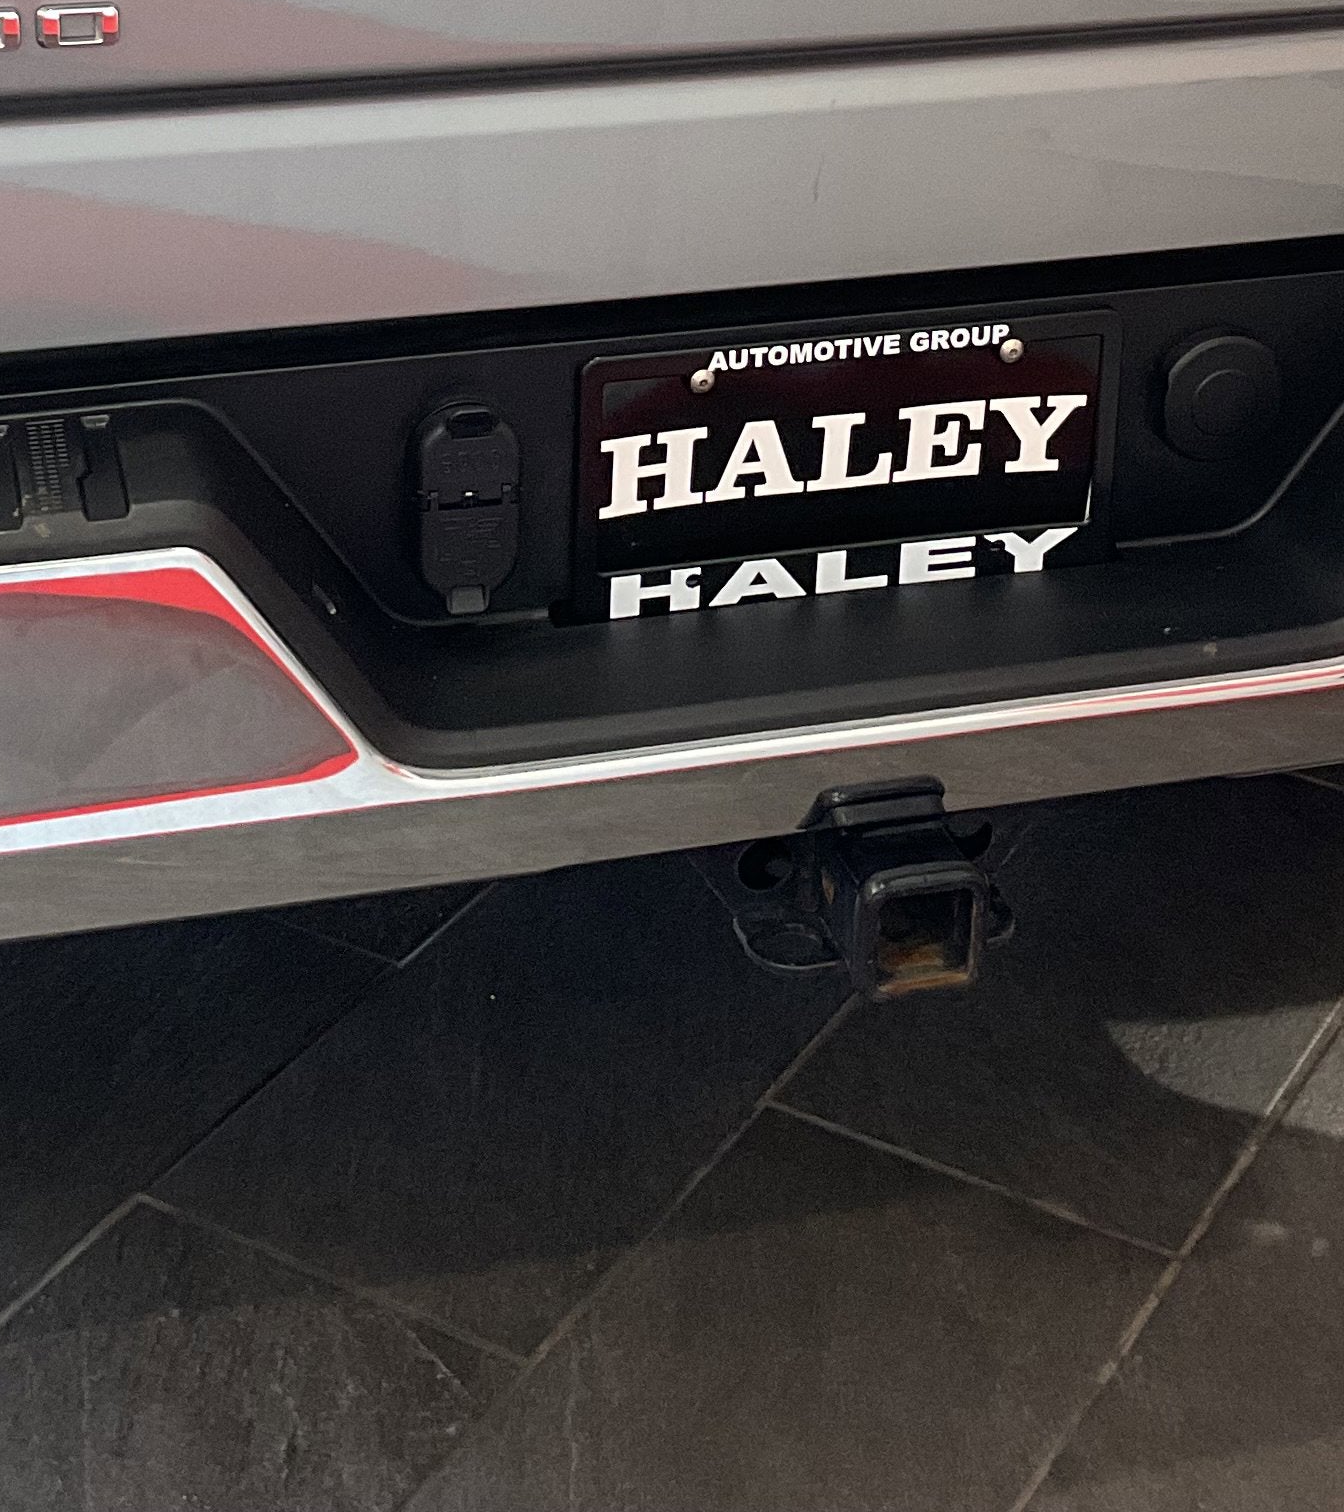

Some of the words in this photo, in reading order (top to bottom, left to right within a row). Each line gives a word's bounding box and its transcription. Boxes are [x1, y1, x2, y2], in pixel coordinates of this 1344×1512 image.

[708, 334, 901, 373] AUTOMOTIVE
[908, 324, 1011, 354] GROUP
[598, 394, 1089, 520] HALEY
[609, 526, 1079, 620] HALEY
